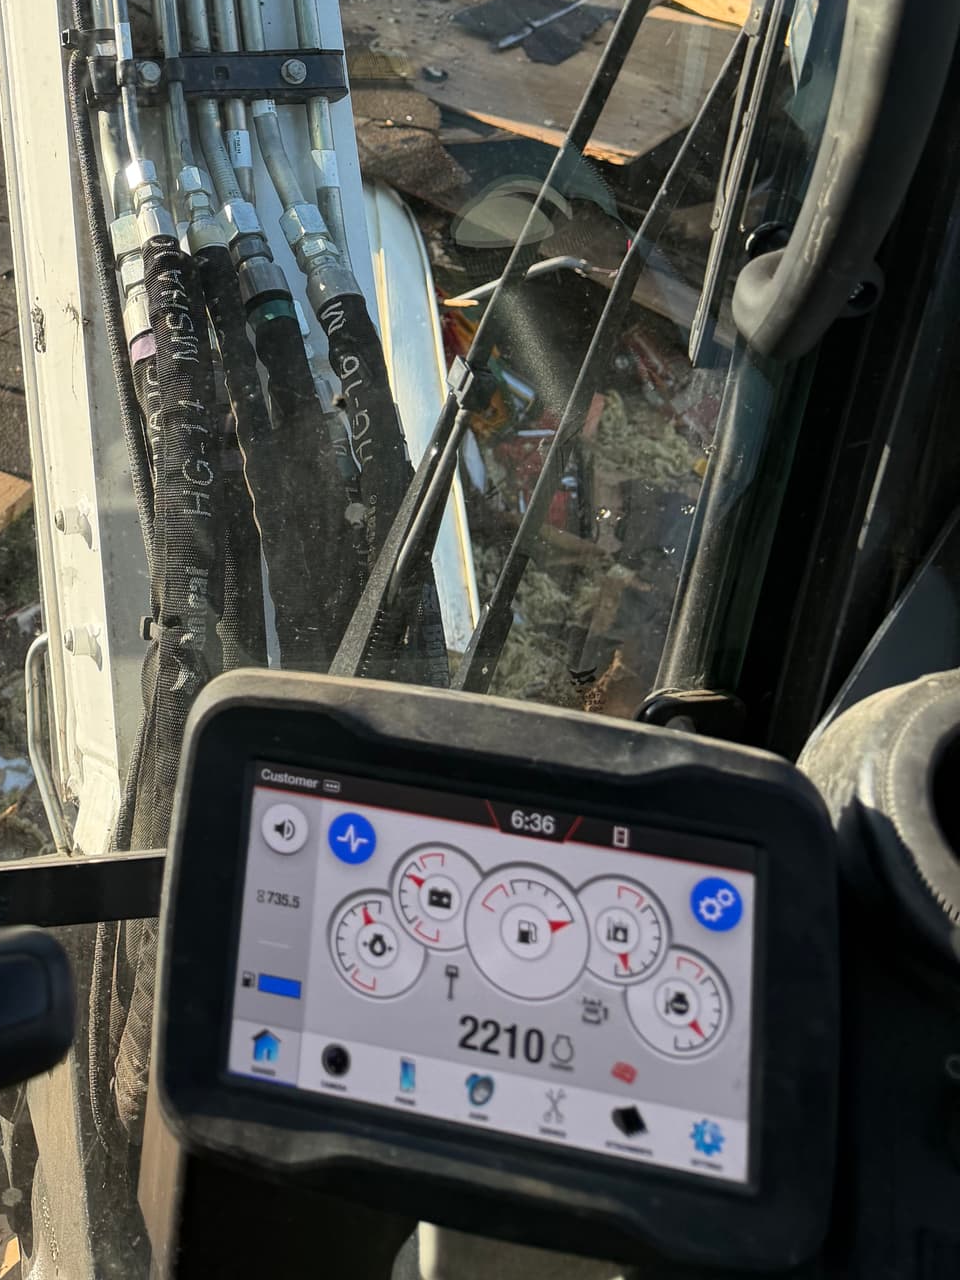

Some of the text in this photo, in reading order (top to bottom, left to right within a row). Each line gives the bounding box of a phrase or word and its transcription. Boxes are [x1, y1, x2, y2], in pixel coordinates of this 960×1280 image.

[260, 768, 319, 789] Customer
[511, 809, 555, 834] 6:36
[267, 890, 301, 909] 735.5
[458, 1014, 545, 1064] 2210
